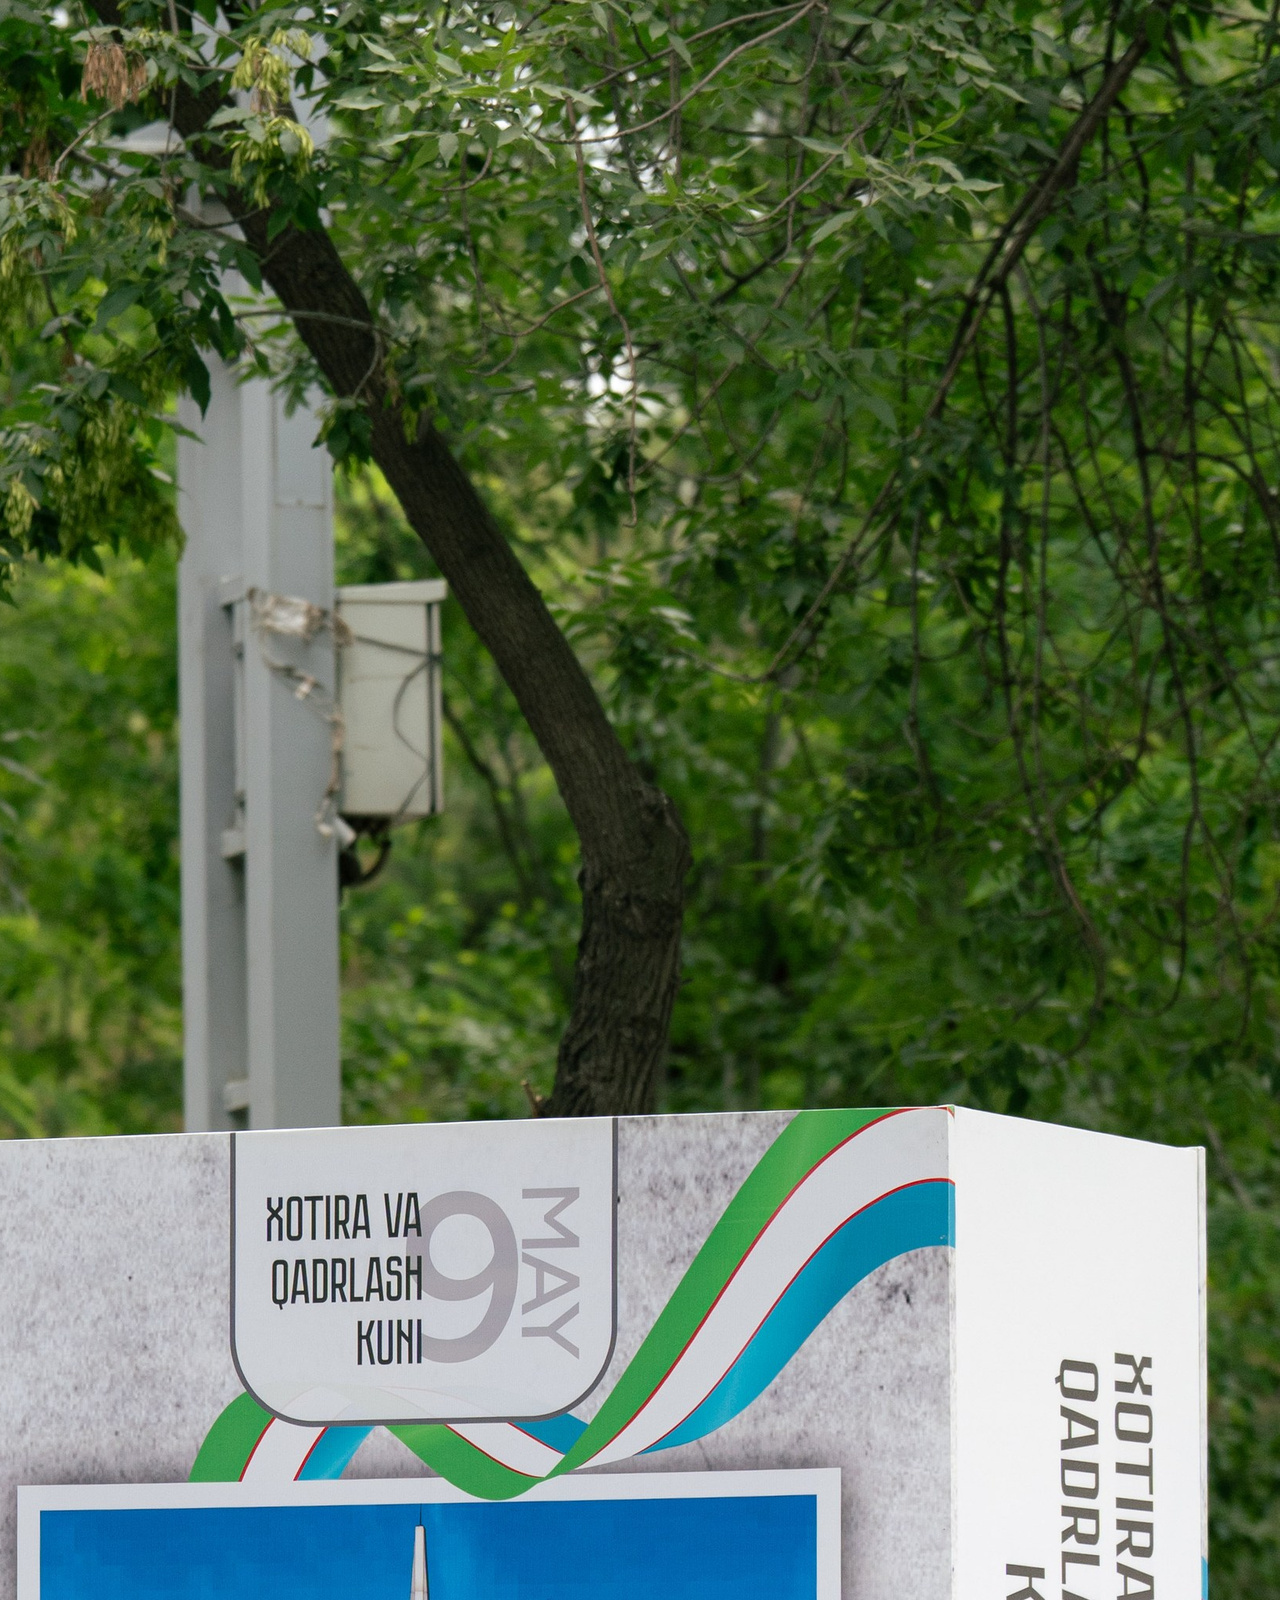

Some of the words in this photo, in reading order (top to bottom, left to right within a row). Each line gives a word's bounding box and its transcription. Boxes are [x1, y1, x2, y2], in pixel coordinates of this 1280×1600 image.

[266, 1194, 371, 1242] XOTIRA
[384, 1192, 423, 1238] VA
[271, 1255, 423, 1310] QADRLASH
[405, 1190, 519, 1364] 9
[521, 1186, 580, 1360] MAY
[356, 1318, 423, 1366] KUNI
